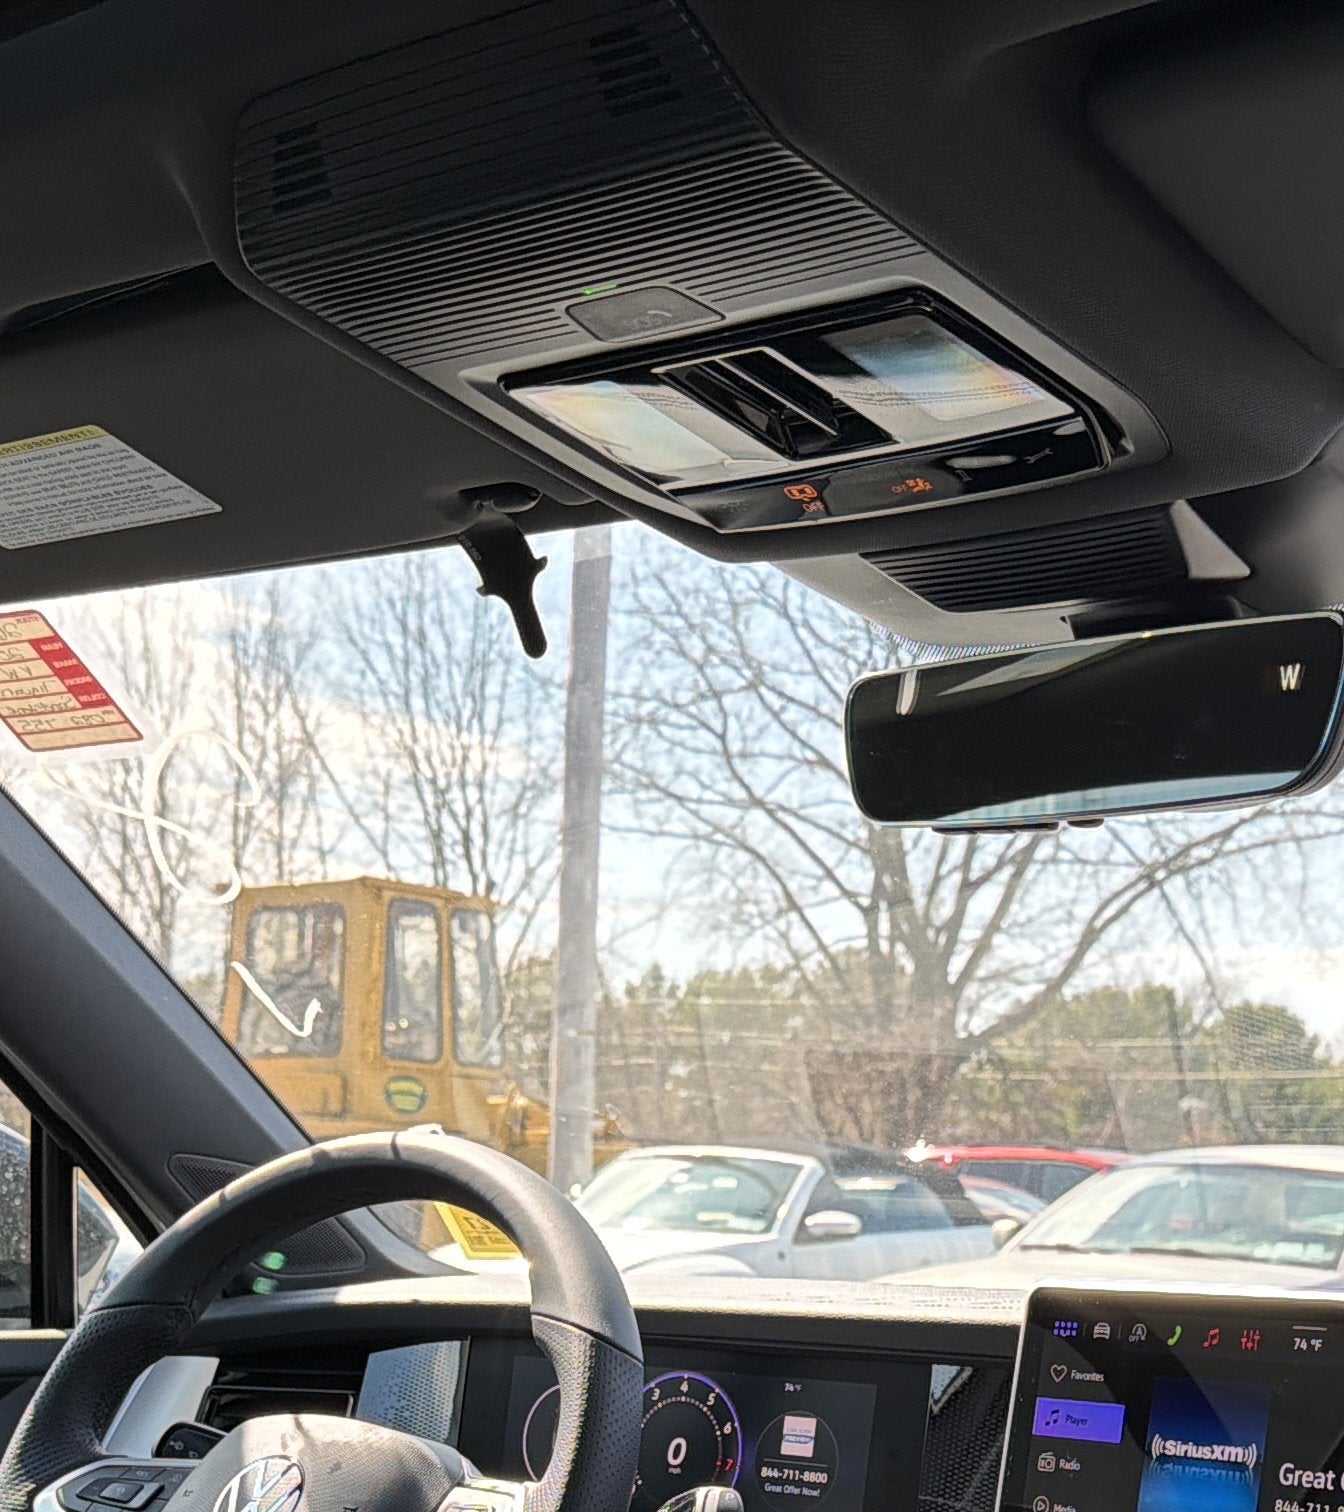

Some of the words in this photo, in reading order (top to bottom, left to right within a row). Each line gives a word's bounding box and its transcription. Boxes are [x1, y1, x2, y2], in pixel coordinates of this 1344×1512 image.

[1279, 664, 1302, 690] W
[1293, 1337, 1308, 1351] 74
[1070, 1369, 1105, 1383] Favorites
[651, 1387, 661, 1401] 3
[680, 1380, 689, 1394] 4
[706, 1392, 717, 1406] 5
[1065, 1414, 1089, 1428] Player
[722, 1421, 733, 1436] 6
[666, 1436, 688, 1467] 0
[1058, 1458, 1081, 1472] Radio
[760, 1466, 828, 1485] 844-711-8800
[1278, 1461, 1336, 1492] Great
[764, 1482, 783, 1494] Great
[783, 1484, 801, 1496] Offer
[802, 1486, 821, 1498] Now!
